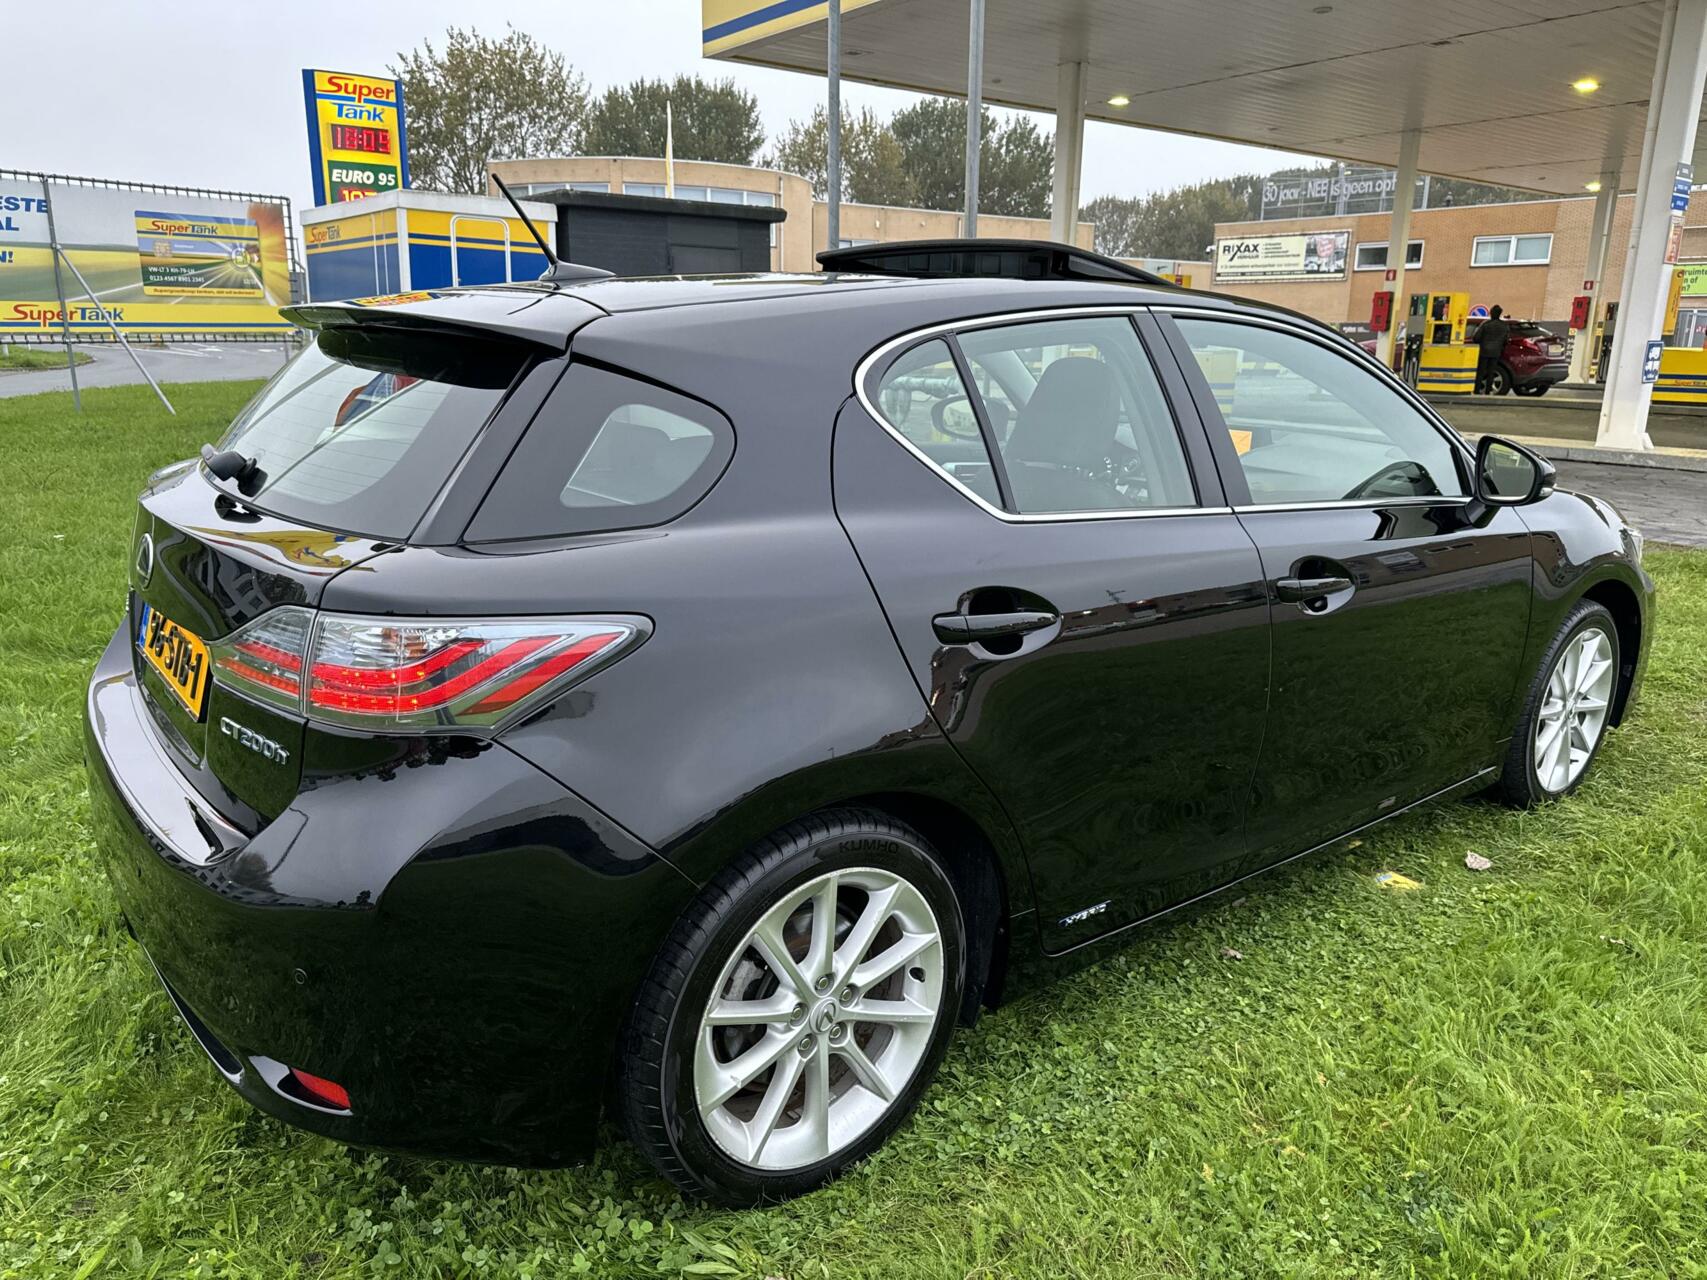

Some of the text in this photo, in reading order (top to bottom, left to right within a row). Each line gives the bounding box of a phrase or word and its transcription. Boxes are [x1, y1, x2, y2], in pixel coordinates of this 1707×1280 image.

[316, 76, 395, 103] Super
[330, 102, 384, 123] Tank
[331, 168, 395, 186] EURO 95
[1342, 182, 1373, 201] geen
[0, 196, 49, 214] STE
[3, 304, 124, 327] SuperTank
[838, 838, 899, 854] KUMHO
